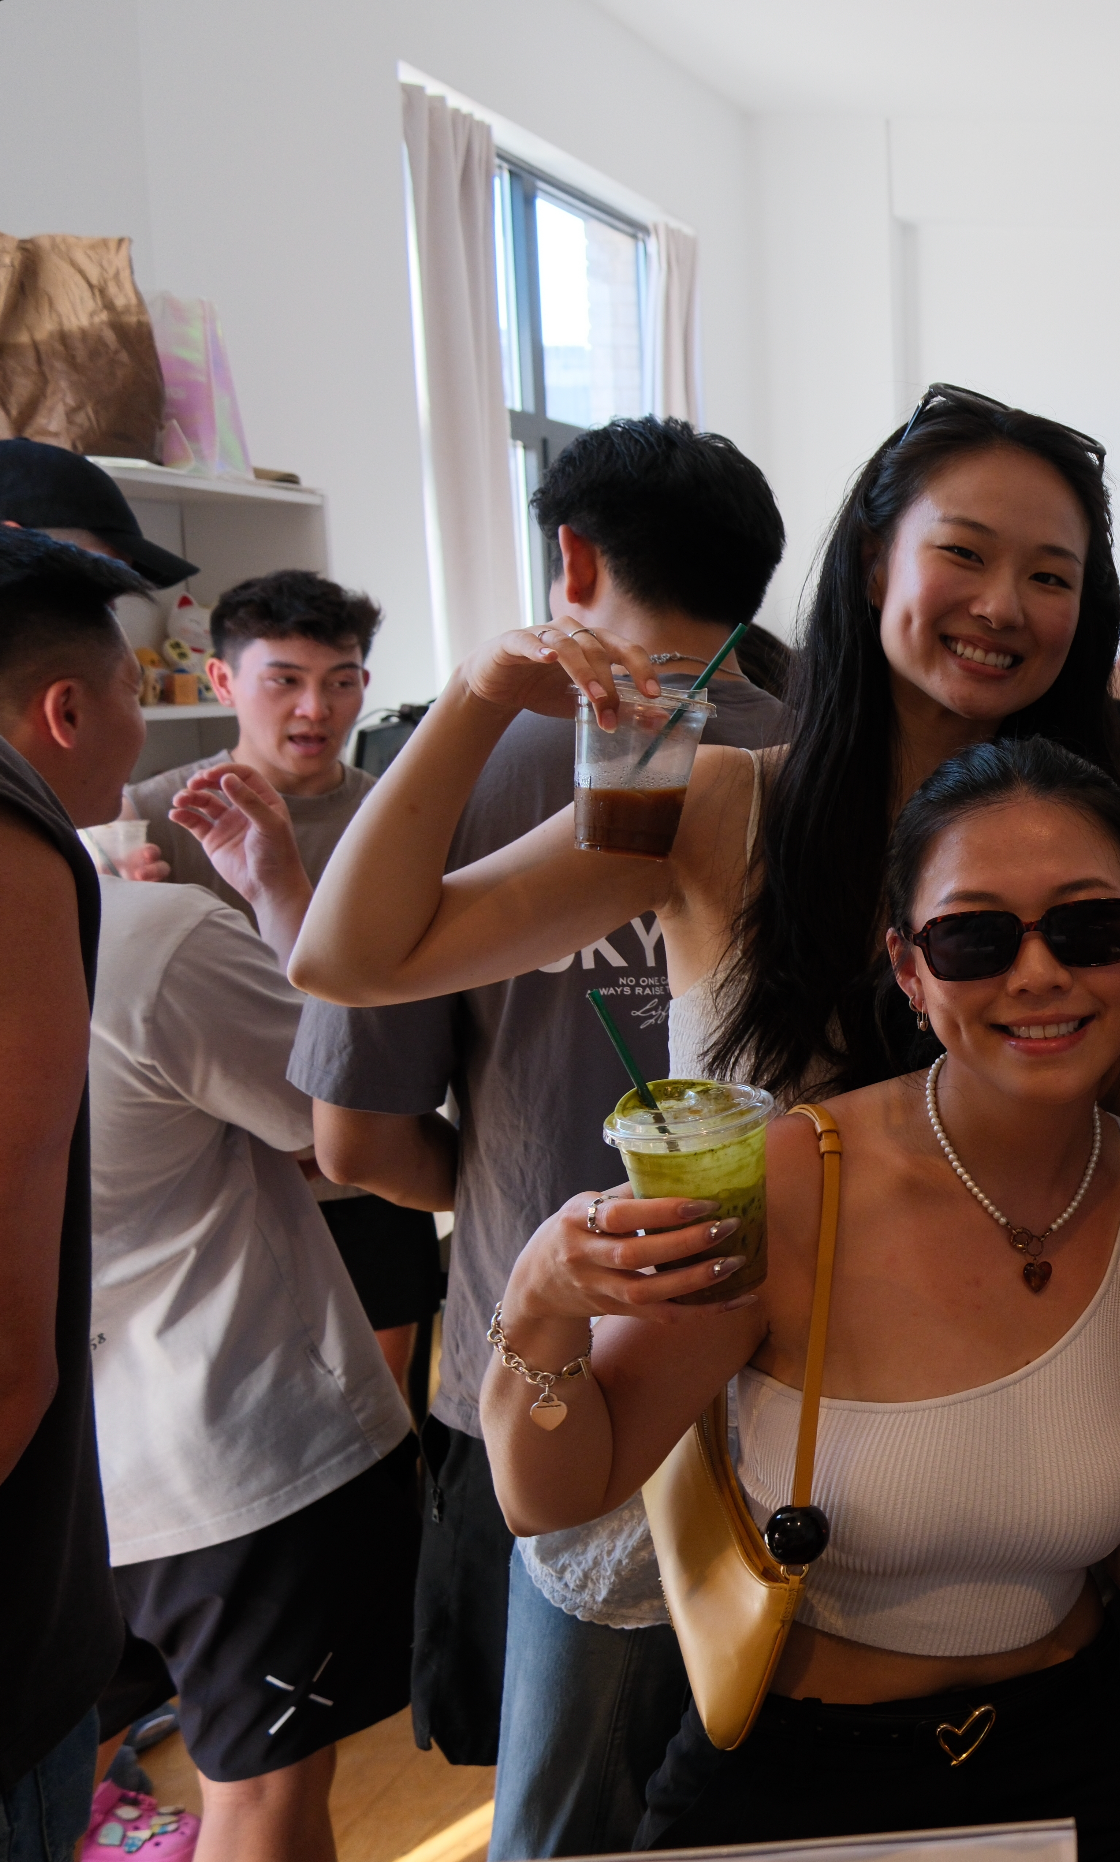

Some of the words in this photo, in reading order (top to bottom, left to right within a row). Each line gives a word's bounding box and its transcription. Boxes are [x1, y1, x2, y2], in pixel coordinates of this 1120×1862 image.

[537, 916, 663, 973] KY
[619, 977, 636, 985] NO
[639, 977, 660, 986] ONE
[635, 986, 665, 995] RAISE
